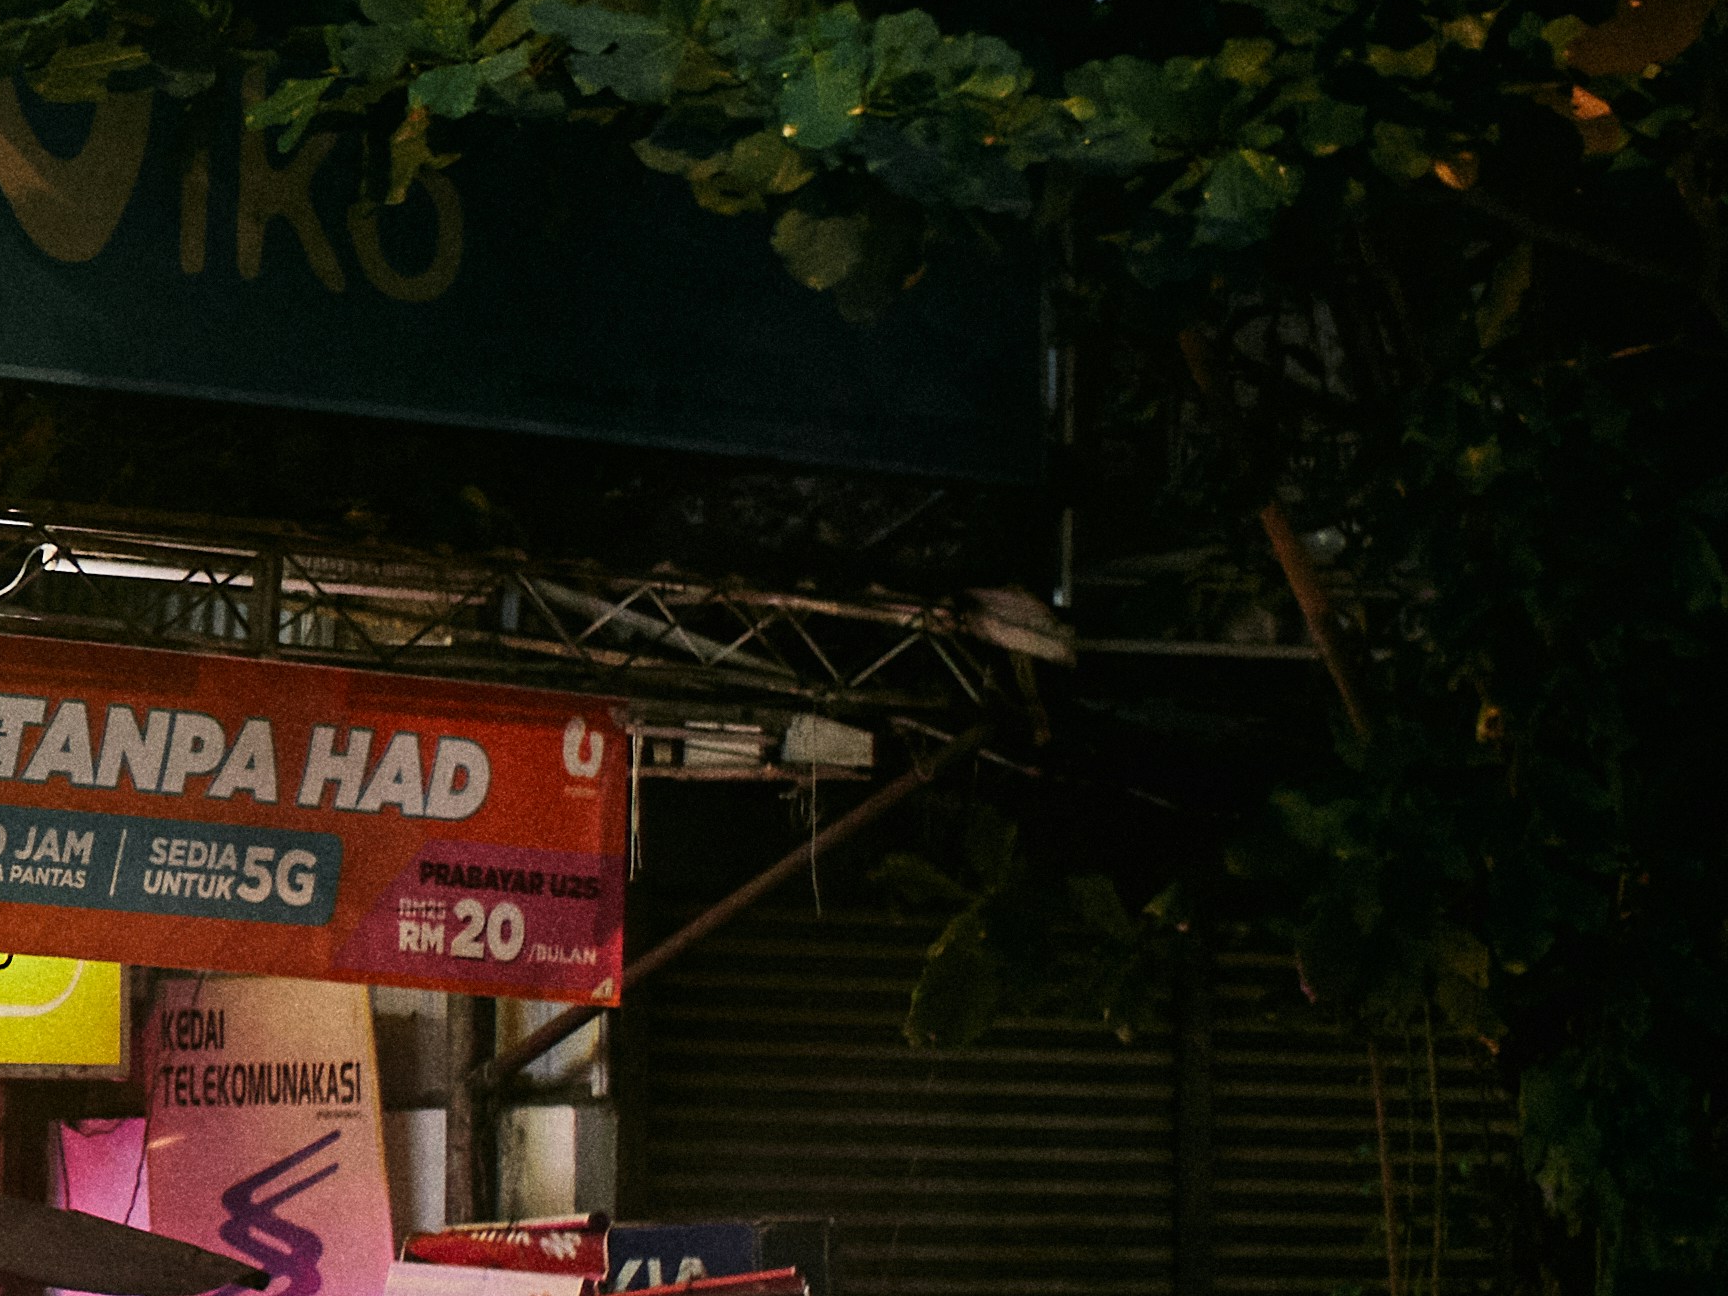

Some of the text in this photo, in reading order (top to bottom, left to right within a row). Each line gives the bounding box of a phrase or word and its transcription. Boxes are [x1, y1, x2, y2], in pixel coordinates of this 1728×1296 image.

[295, 722, 493, 822] HAD
[14, 825, 95, 865] JAM
[150, 836, 238, 871] SEDIA
[8, 864, 87, 889] PANTAS
[144, 869, 236, 902] UNTUK
[236, 846, 318, 907] 5G
[419, 860, 545, 896] PRABAYAR
[450, 898, 525, 962] 20
